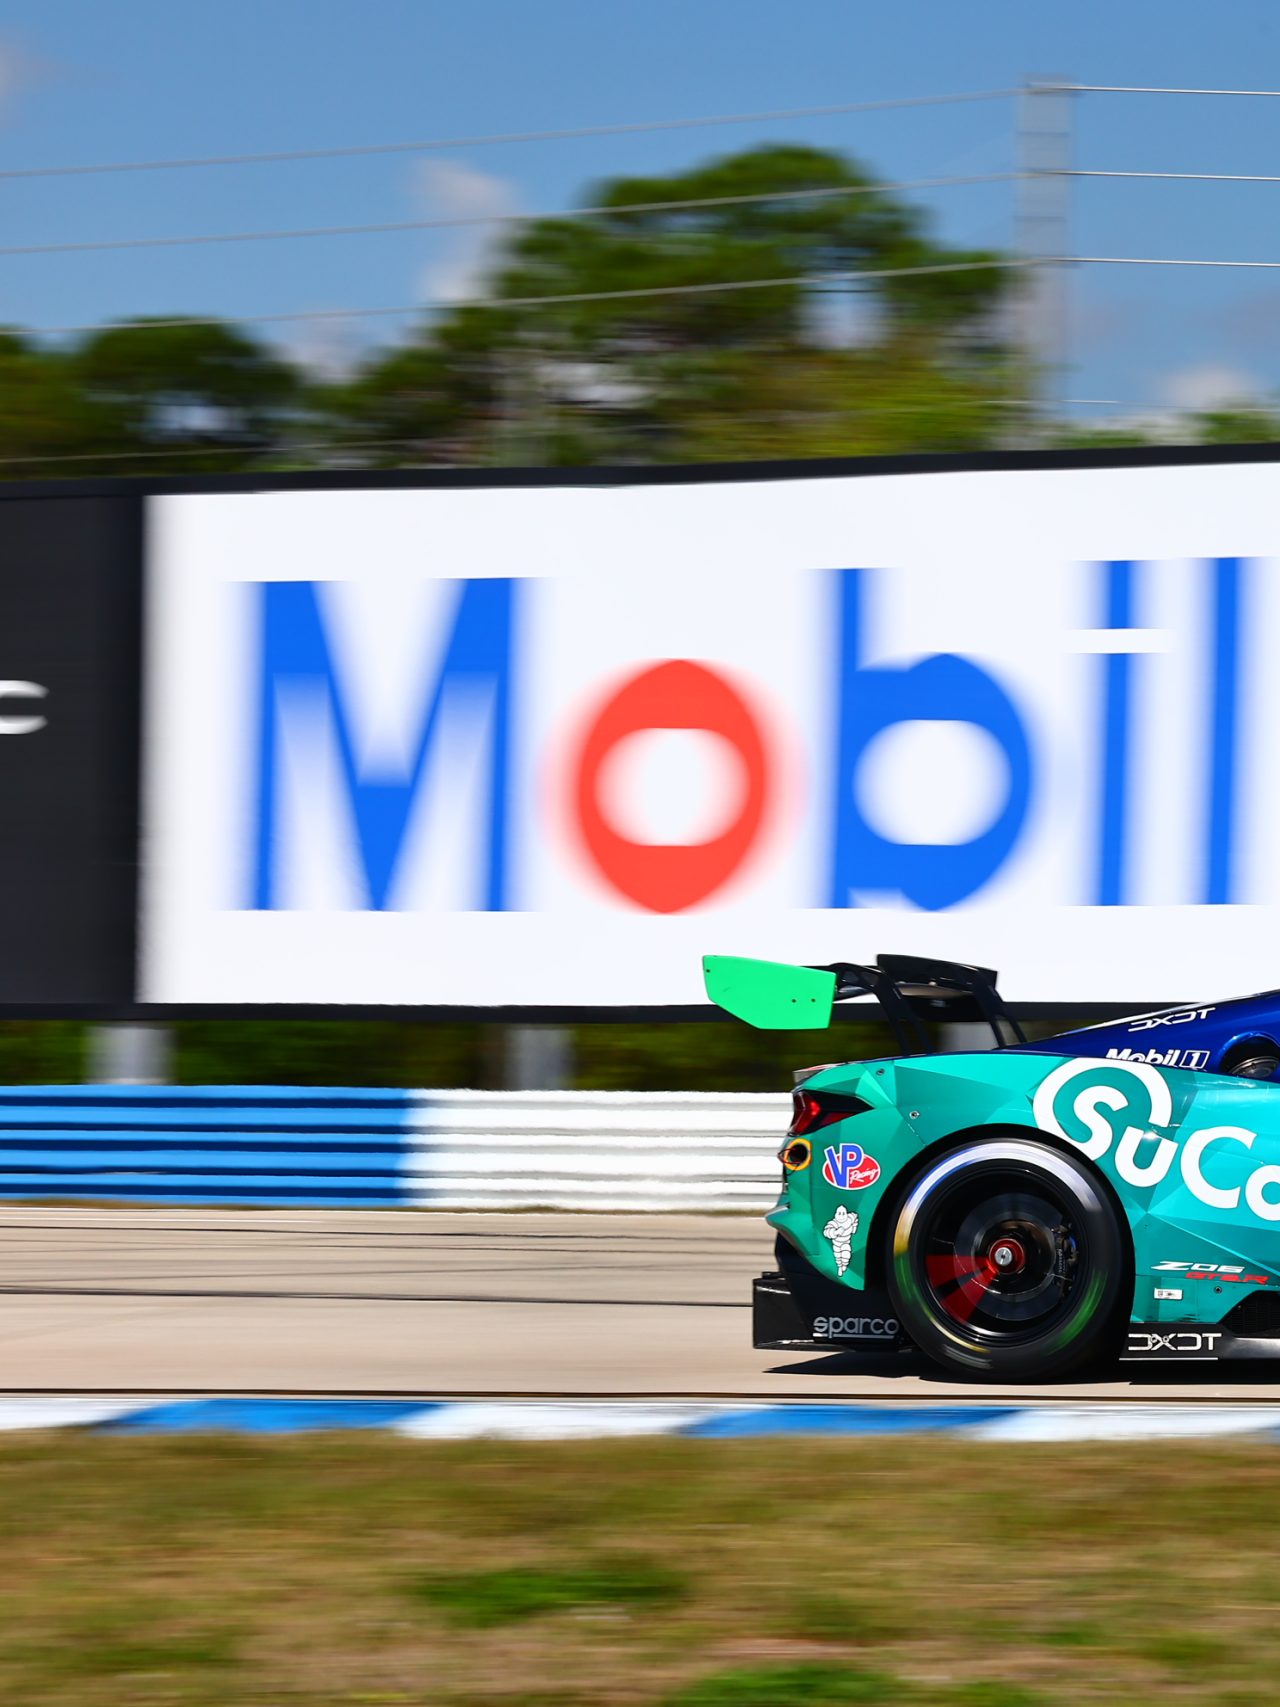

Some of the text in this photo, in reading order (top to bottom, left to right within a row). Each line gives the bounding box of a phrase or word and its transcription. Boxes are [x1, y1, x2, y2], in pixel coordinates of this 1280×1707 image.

[232, 557, 1262, 914] Mobil
[1105, 1048, 1181, 1067] Mobil
[824, 1143, 864, 1188] VP
[849, 1168, 880, 1184] Racing
[813, 1316, 899, 1338] sparco
